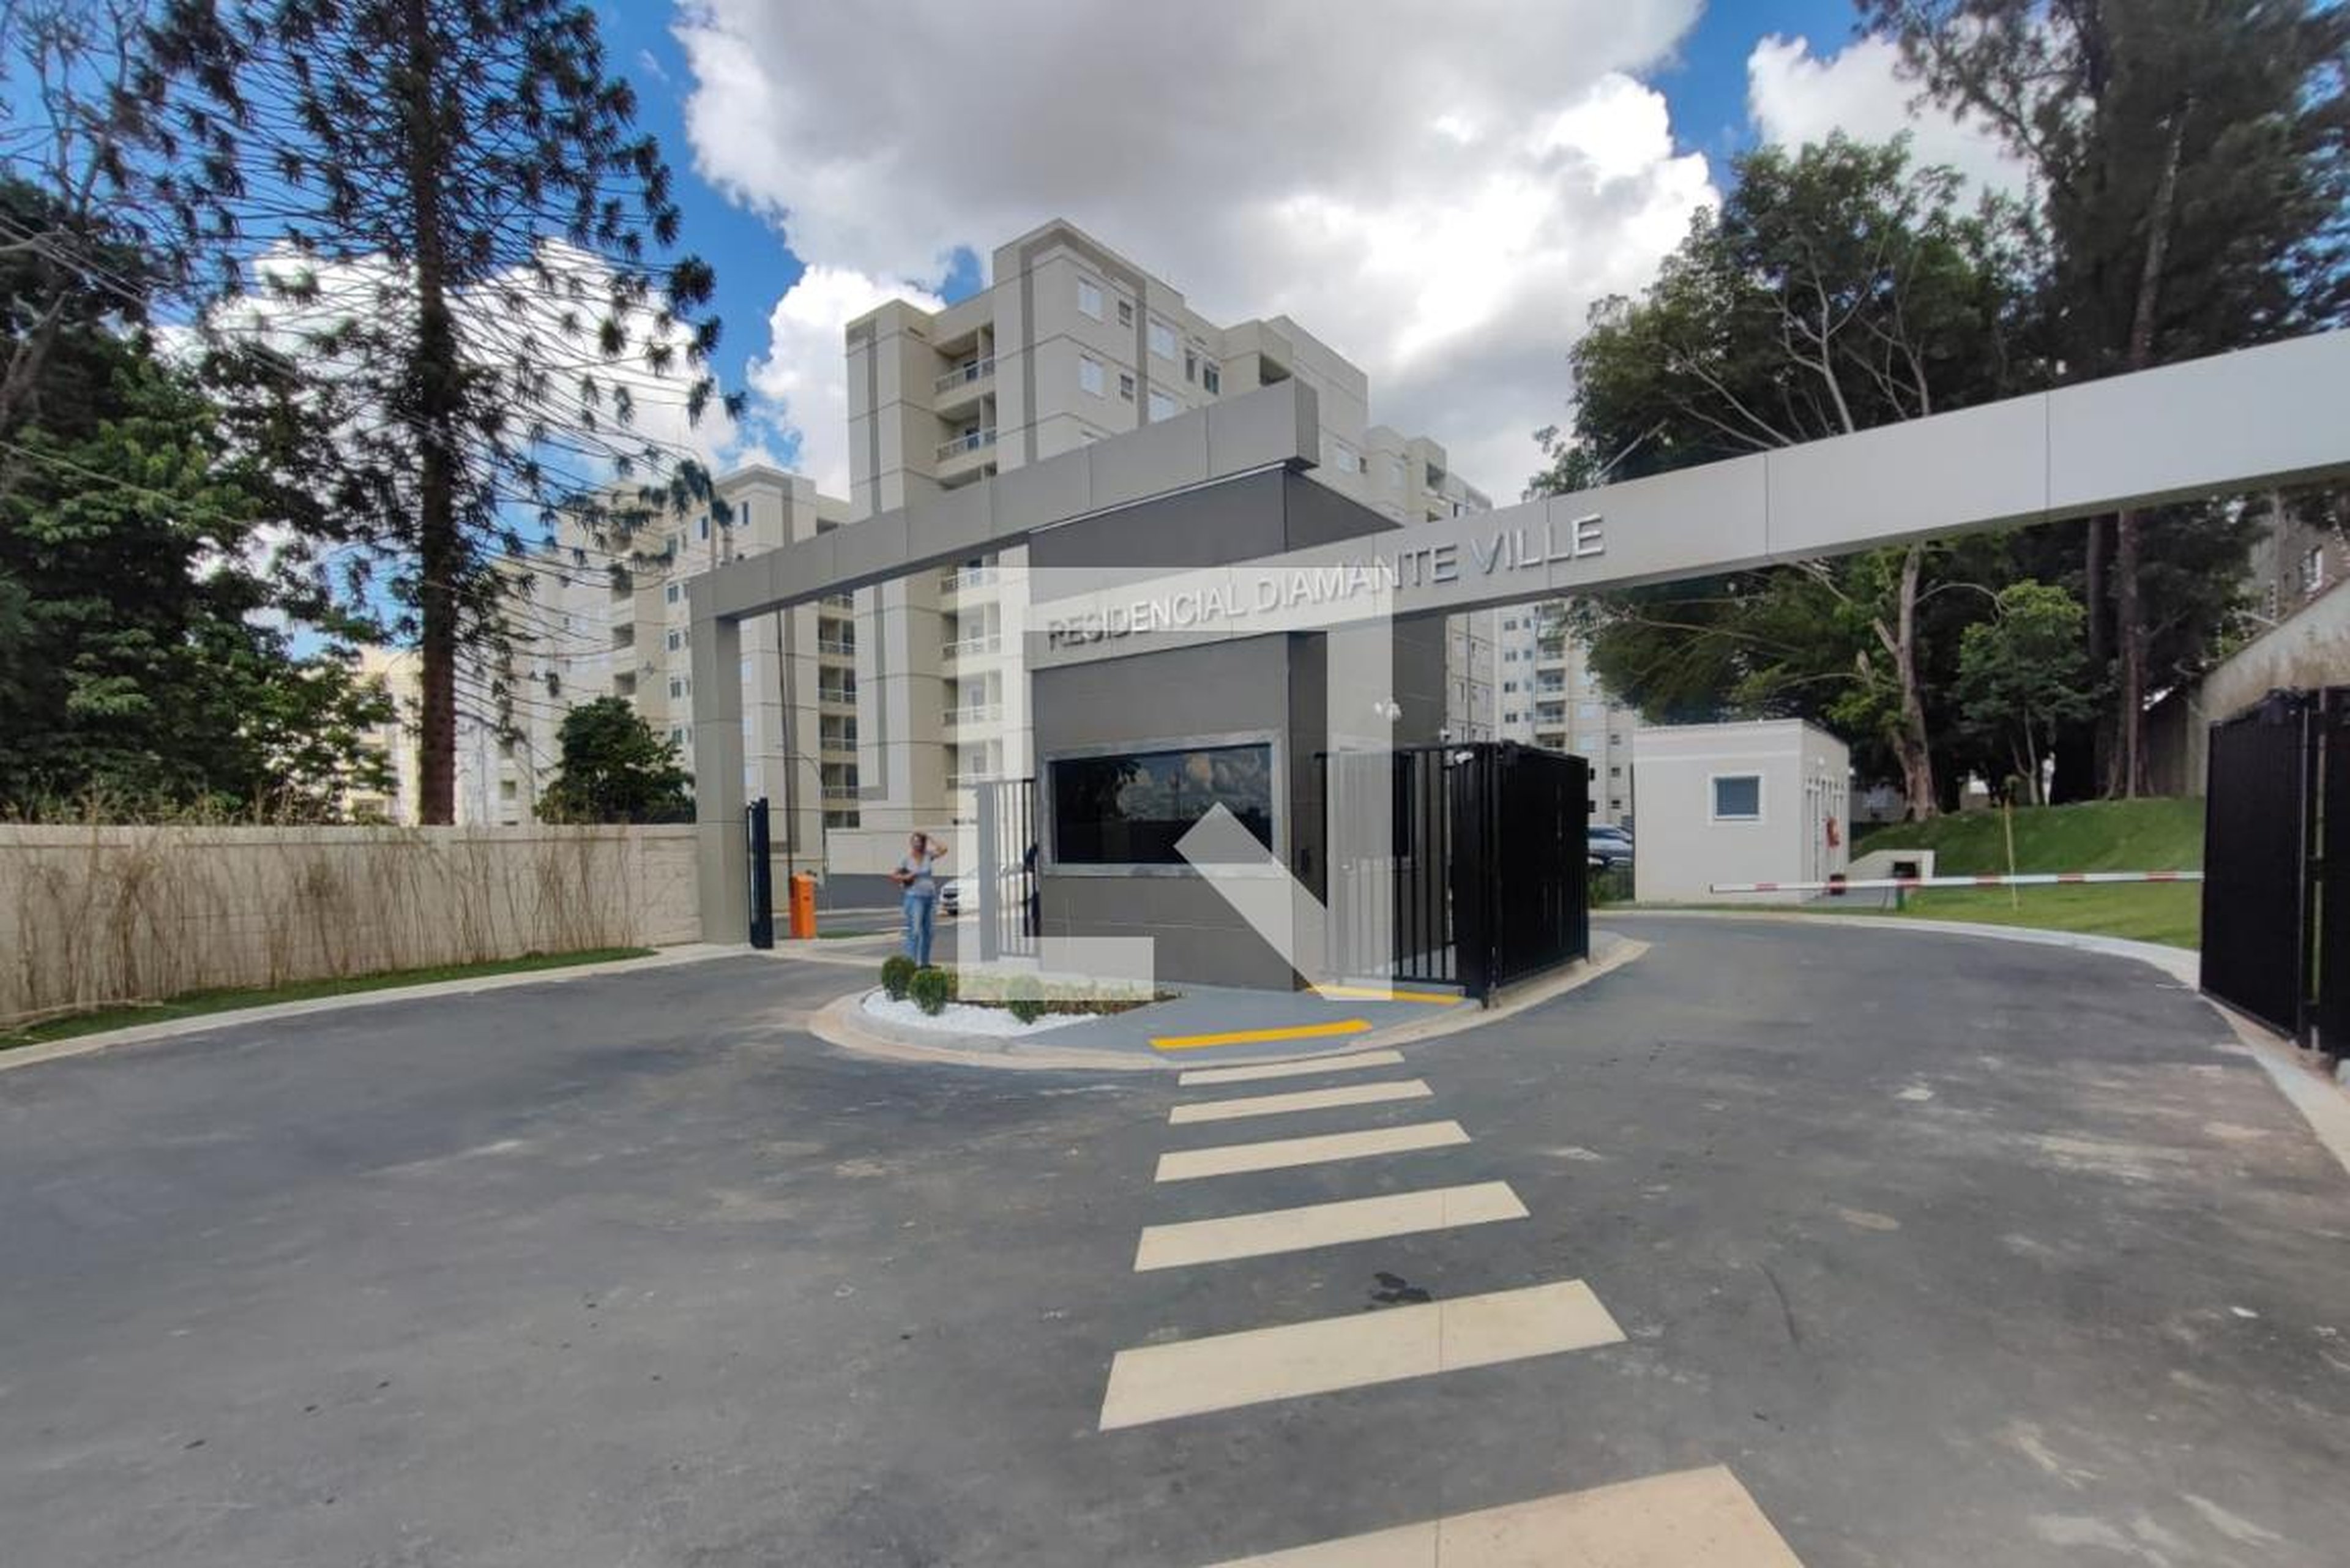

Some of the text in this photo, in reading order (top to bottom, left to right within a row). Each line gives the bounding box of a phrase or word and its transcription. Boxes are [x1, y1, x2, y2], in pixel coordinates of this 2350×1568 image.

[1048, 513, 1605, 652] RESIDENCIAL DIAMANTE VILLE
